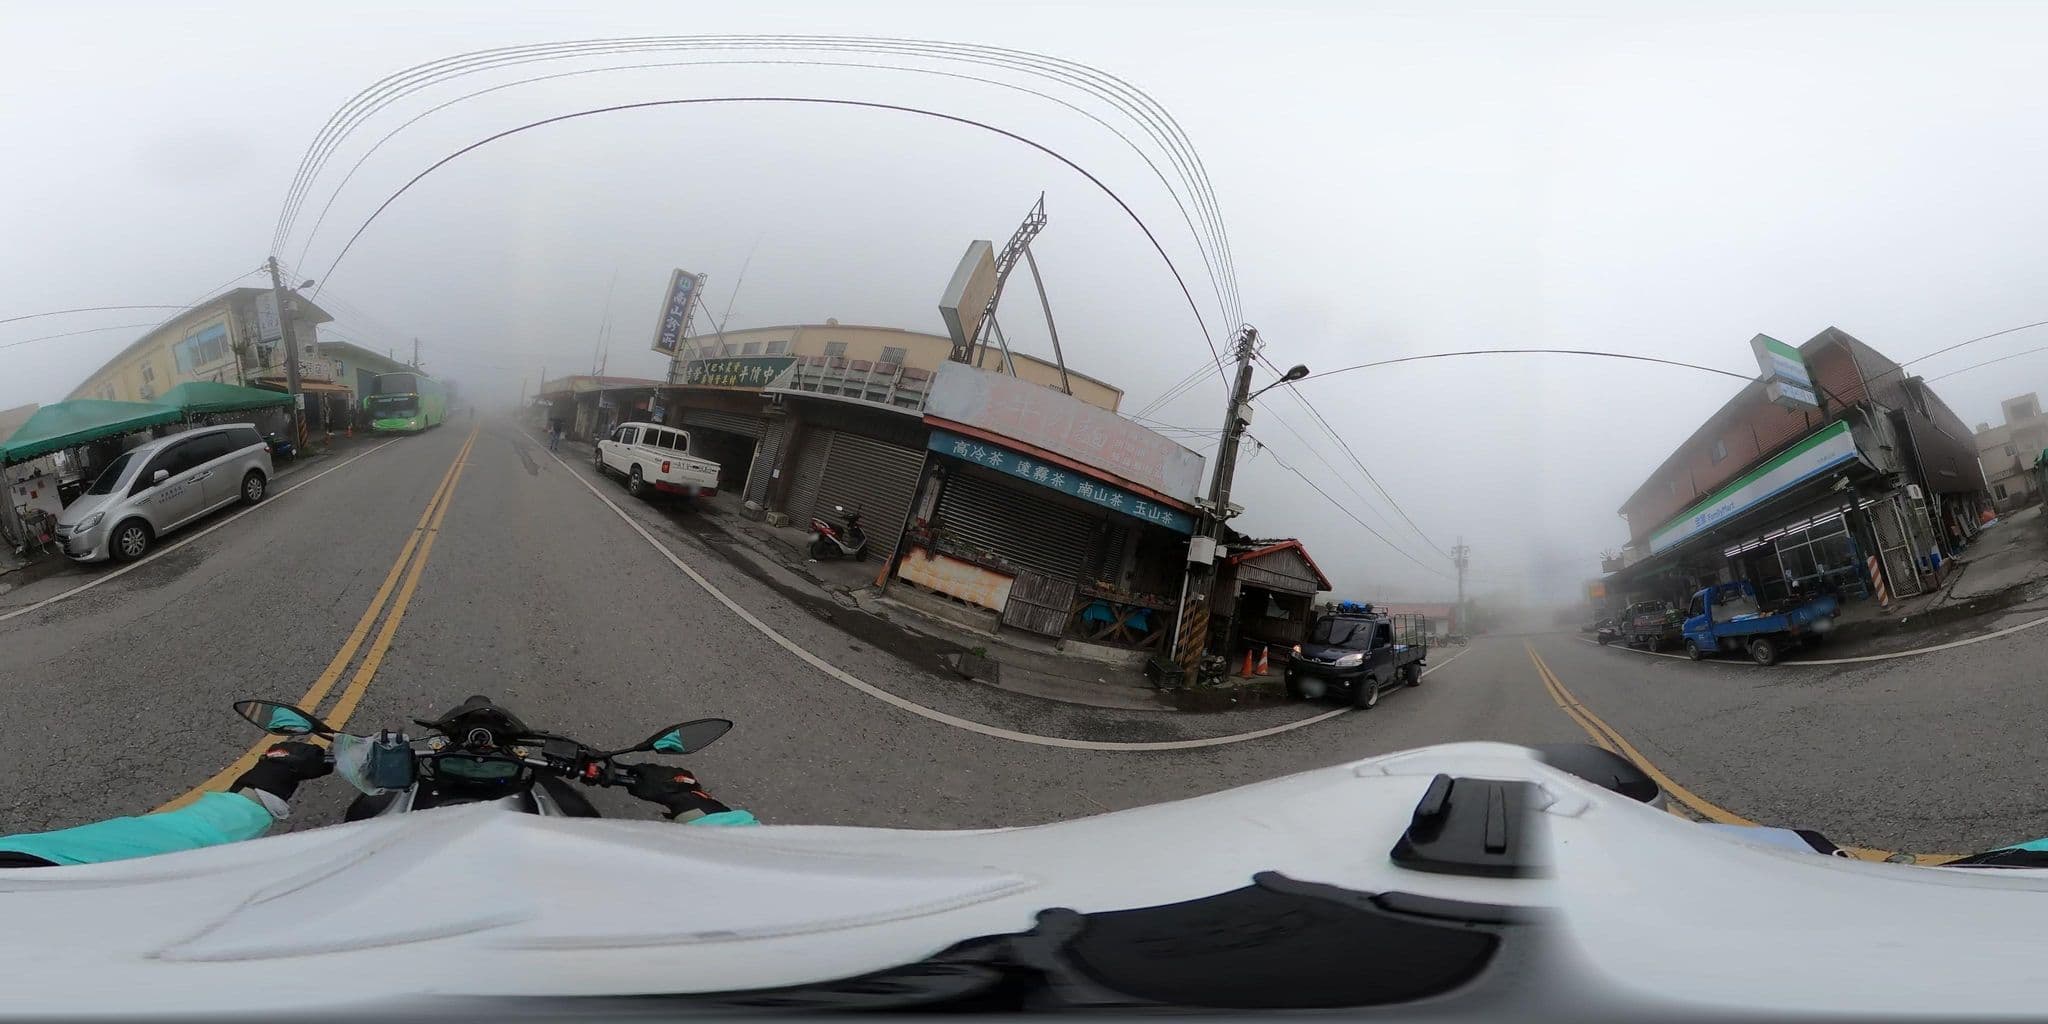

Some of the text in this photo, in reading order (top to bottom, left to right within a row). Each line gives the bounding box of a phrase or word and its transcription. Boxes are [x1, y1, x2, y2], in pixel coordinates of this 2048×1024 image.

[953, 440, 1004, 466] 高冷茶
[1077, 481, 1123, 507] 南山茶
[1133, 500, 1174, 524] 玉山茶
